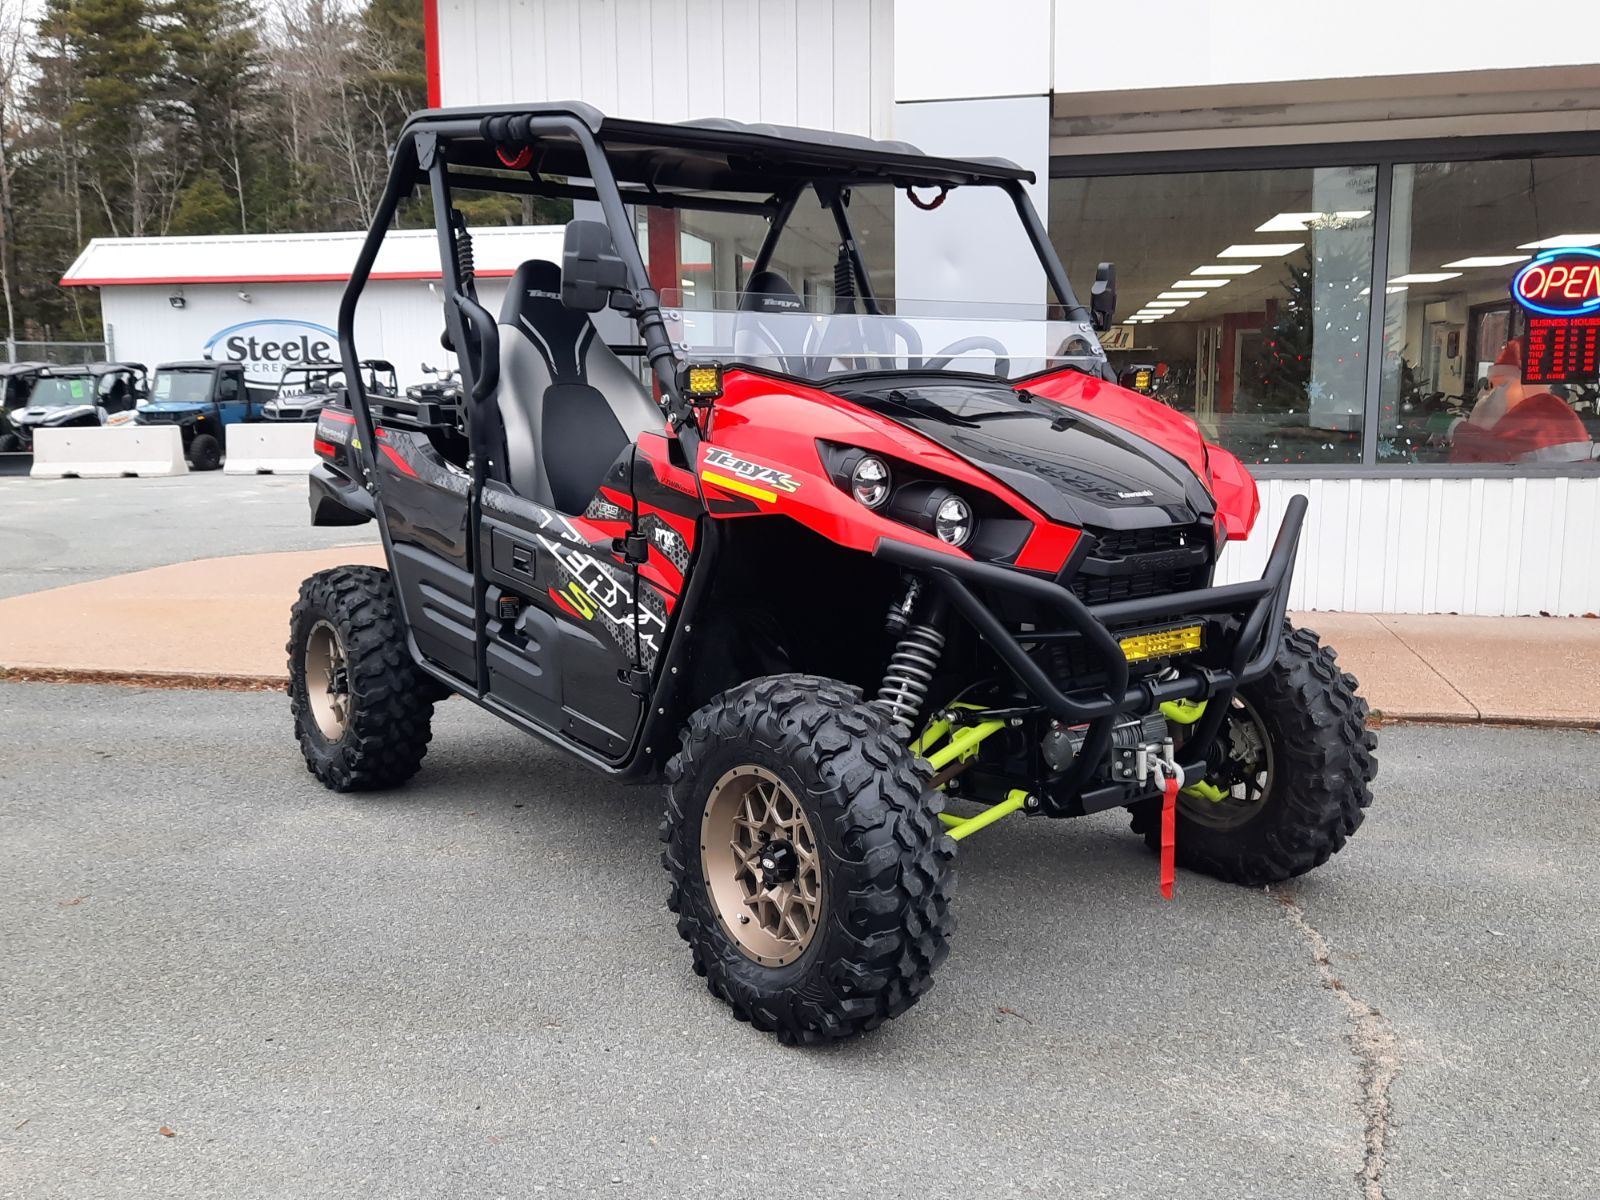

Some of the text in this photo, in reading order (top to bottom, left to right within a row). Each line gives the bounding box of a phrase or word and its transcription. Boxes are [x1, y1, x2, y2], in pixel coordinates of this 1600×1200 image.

[1520, 266, 1600, 298] OPEN
[226, 335, 331, 363] Steele
[654, 527, 675, 547] FOX
